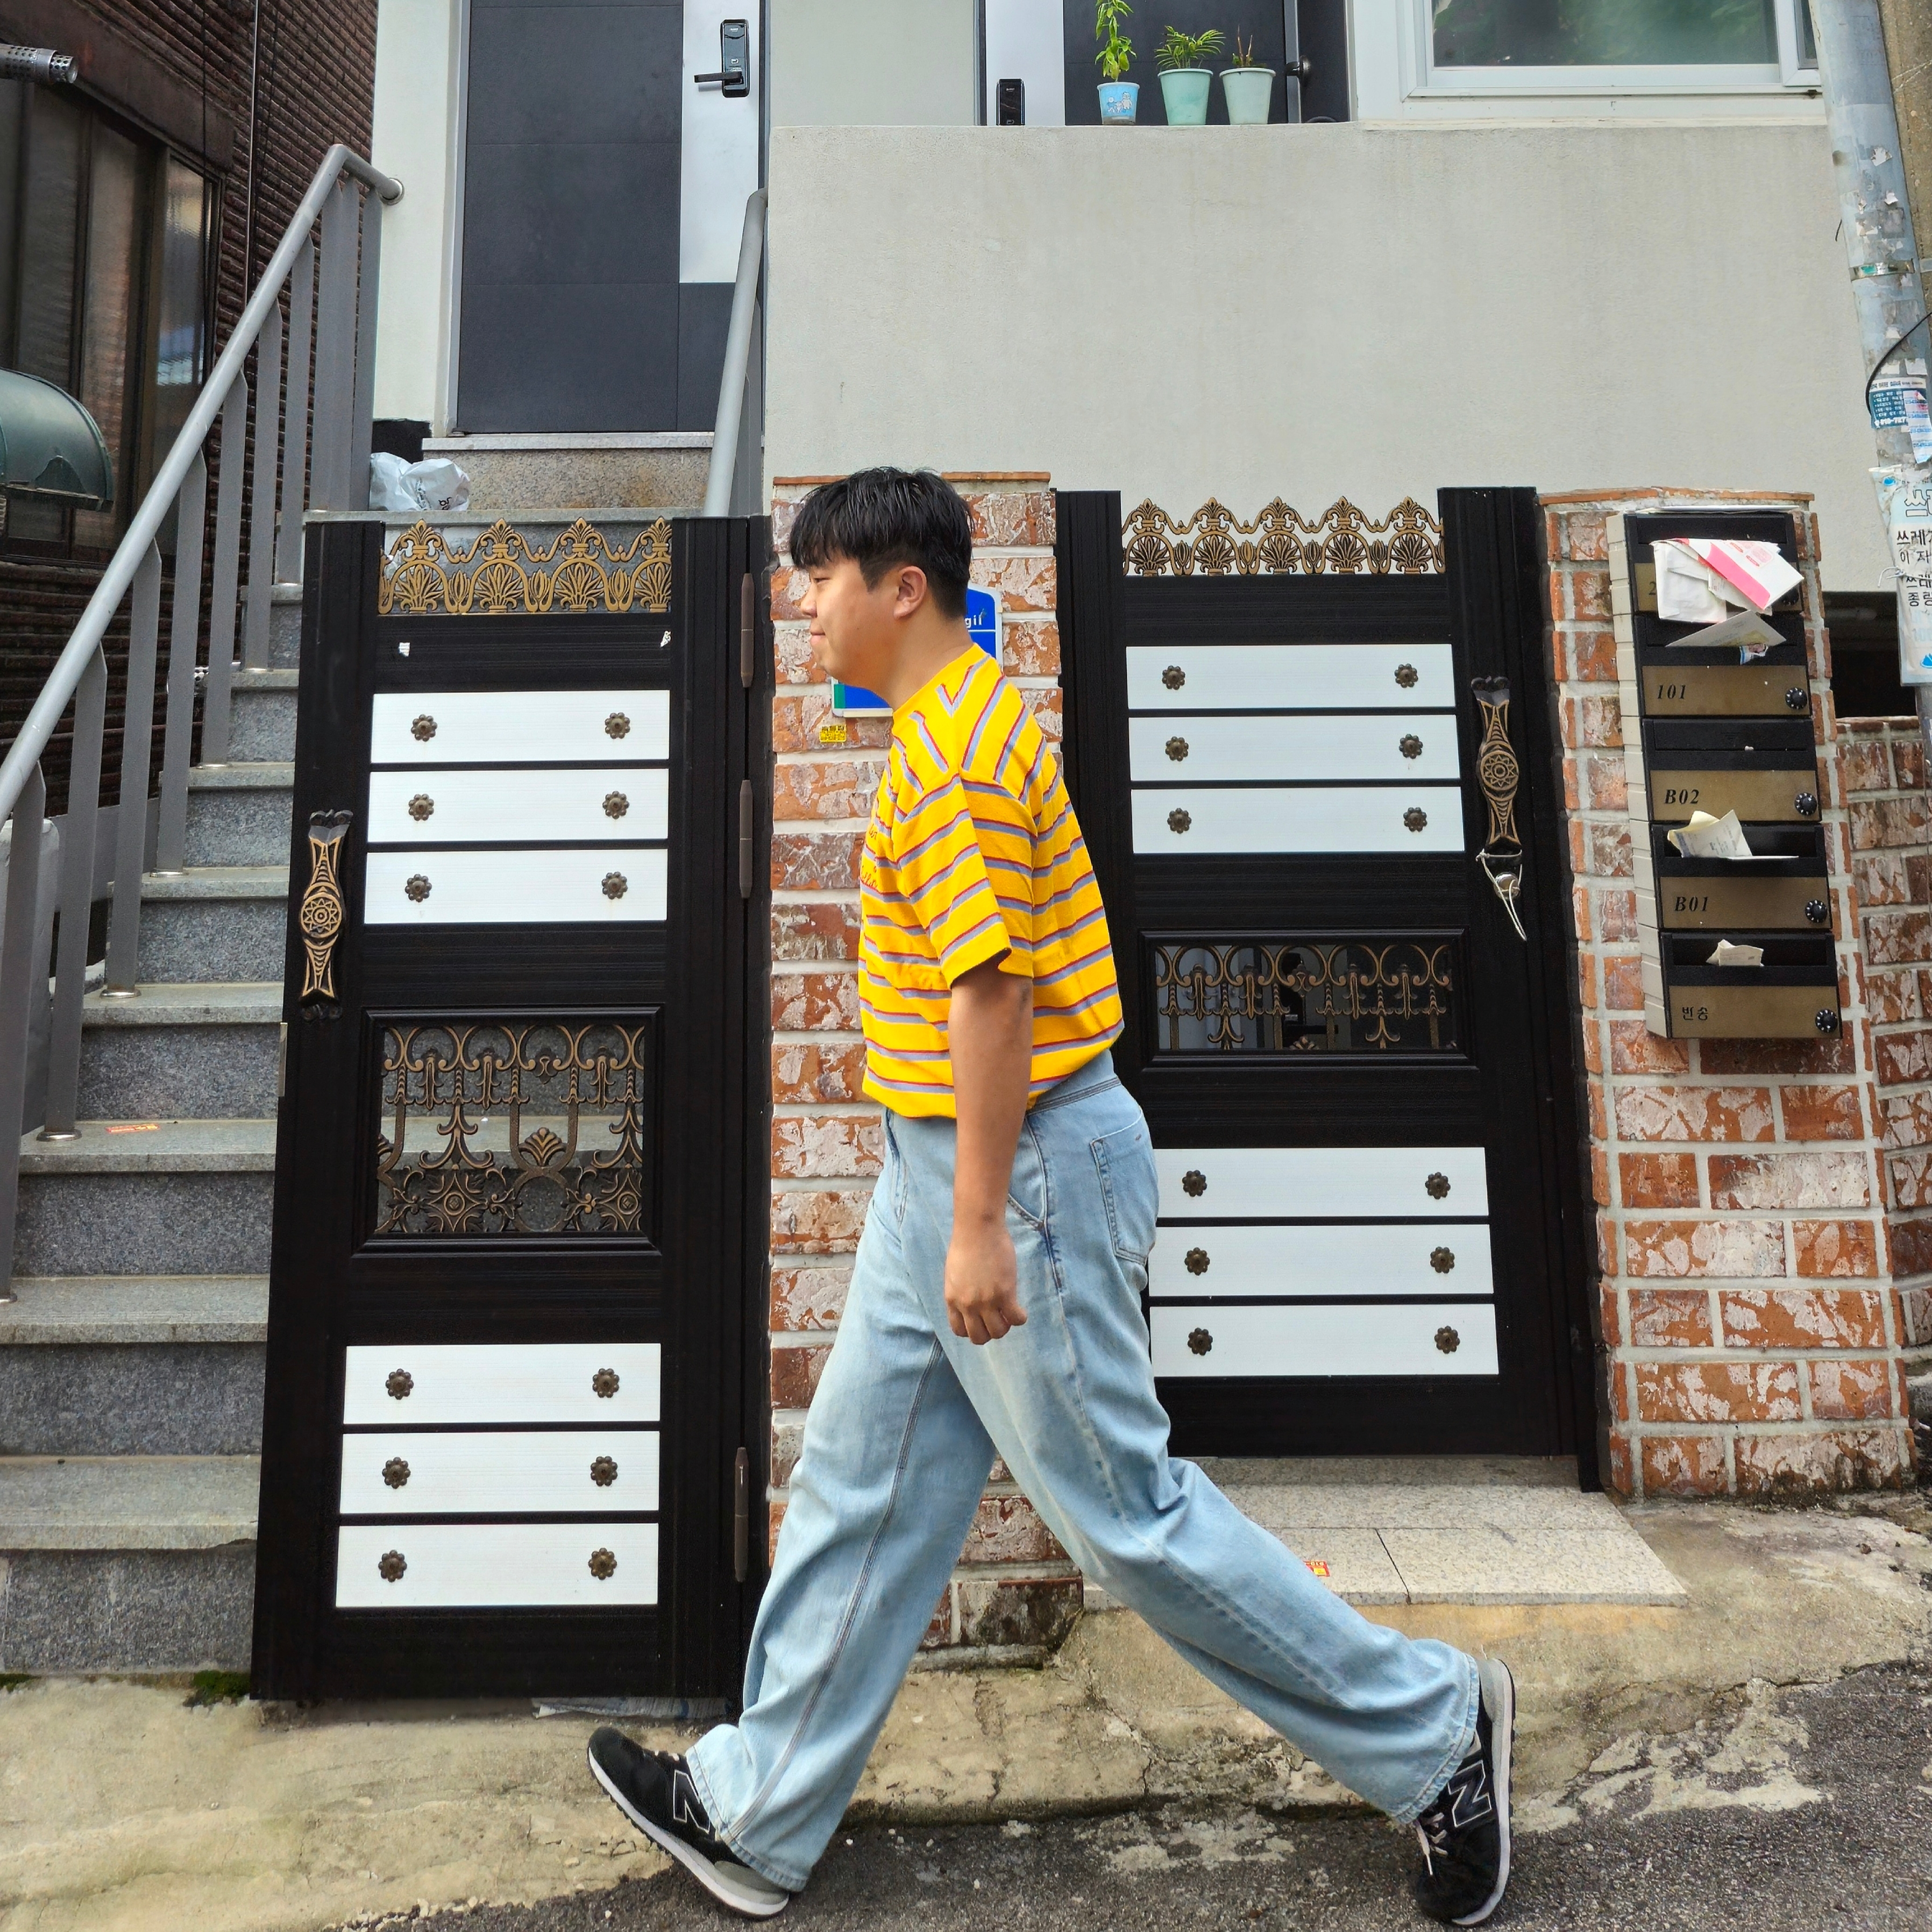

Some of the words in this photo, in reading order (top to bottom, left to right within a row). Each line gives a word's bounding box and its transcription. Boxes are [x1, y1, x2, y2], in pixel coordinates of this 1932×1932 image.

[1900, 551, 1909, 564] 이
[1657, 684, 1687, 700] 101
[1664, 789, 1700, 805] B02
[1674, 896, 1709, 912] B01
[1682, 1006, 1709, 1021] 반송
